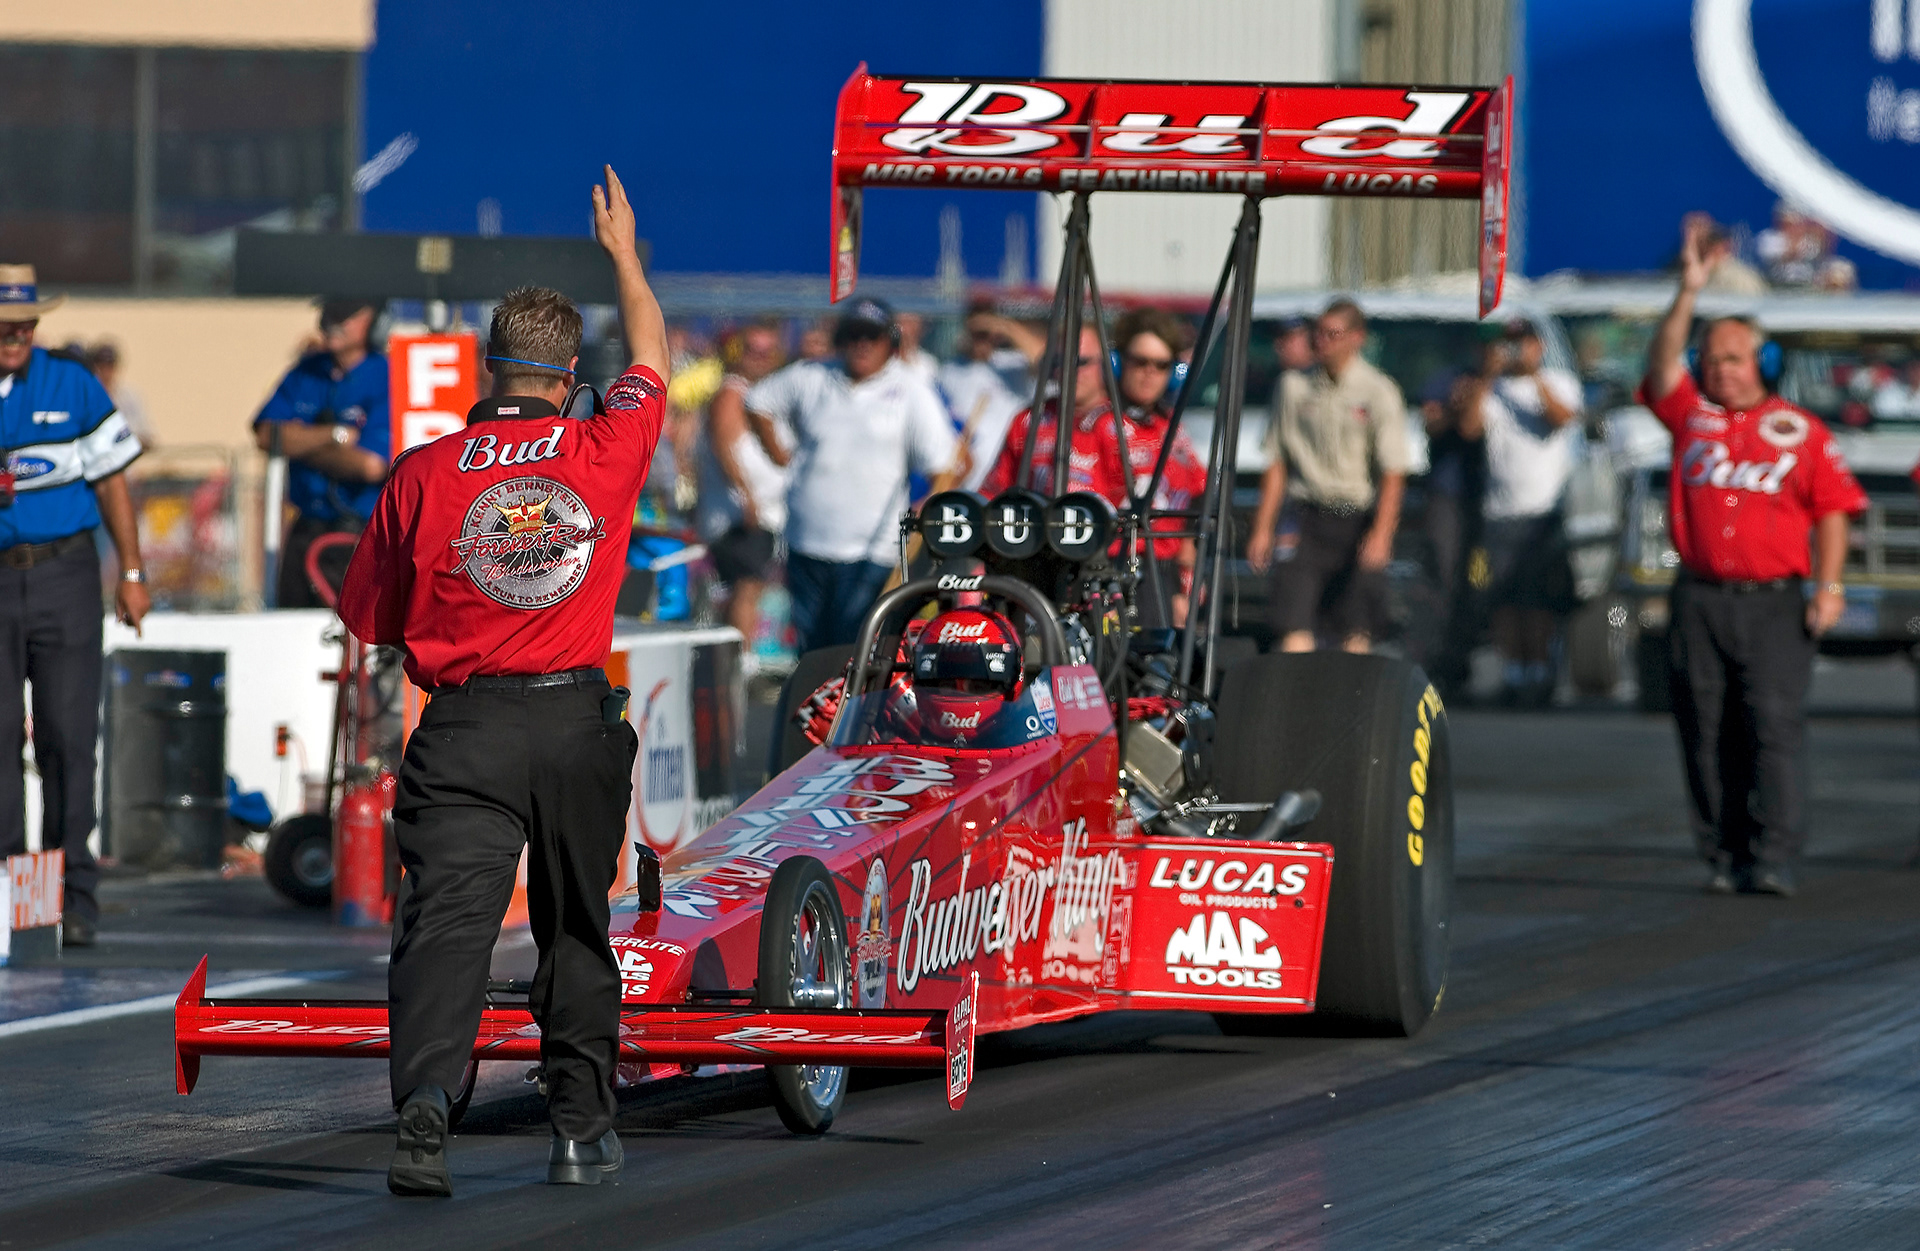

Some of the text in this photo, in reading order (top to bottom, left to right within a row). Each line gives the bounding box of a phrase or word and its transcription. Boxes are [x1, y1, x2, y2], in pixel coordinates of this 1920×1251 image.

[881, 82, 1470, 157] Bud
[945, 165, 1043, 185] TOOLS
[1058, 168, 1268, 193] FEATHERLITE
[1321, 171, 1439, 194] LUCAS
[457, 426, 565, 473] Bud
[1681, 438, 1799, 495] Bud
[470, 481, 582, 529] KENNY BERNSTEIN
[450, 516, 607, 575] Forever Red
[480, 554, 582, 581] Budweiser
[937, 573, 984, 591] Bud
[940, 620, 988, 638] Bud
[940, 710, 981, 729] Bud
[1150, 856, 1310, 895] LUCAS
[1178, 893, 1278, 910] OIL PRODUCTS
[896, 849, 1056, 993] Budweiser
[1165, 910, 1283, 969] MAC
[1166, 966, 1283, 990] TOOLS
[714, 1026, 924, 1045] Bud
